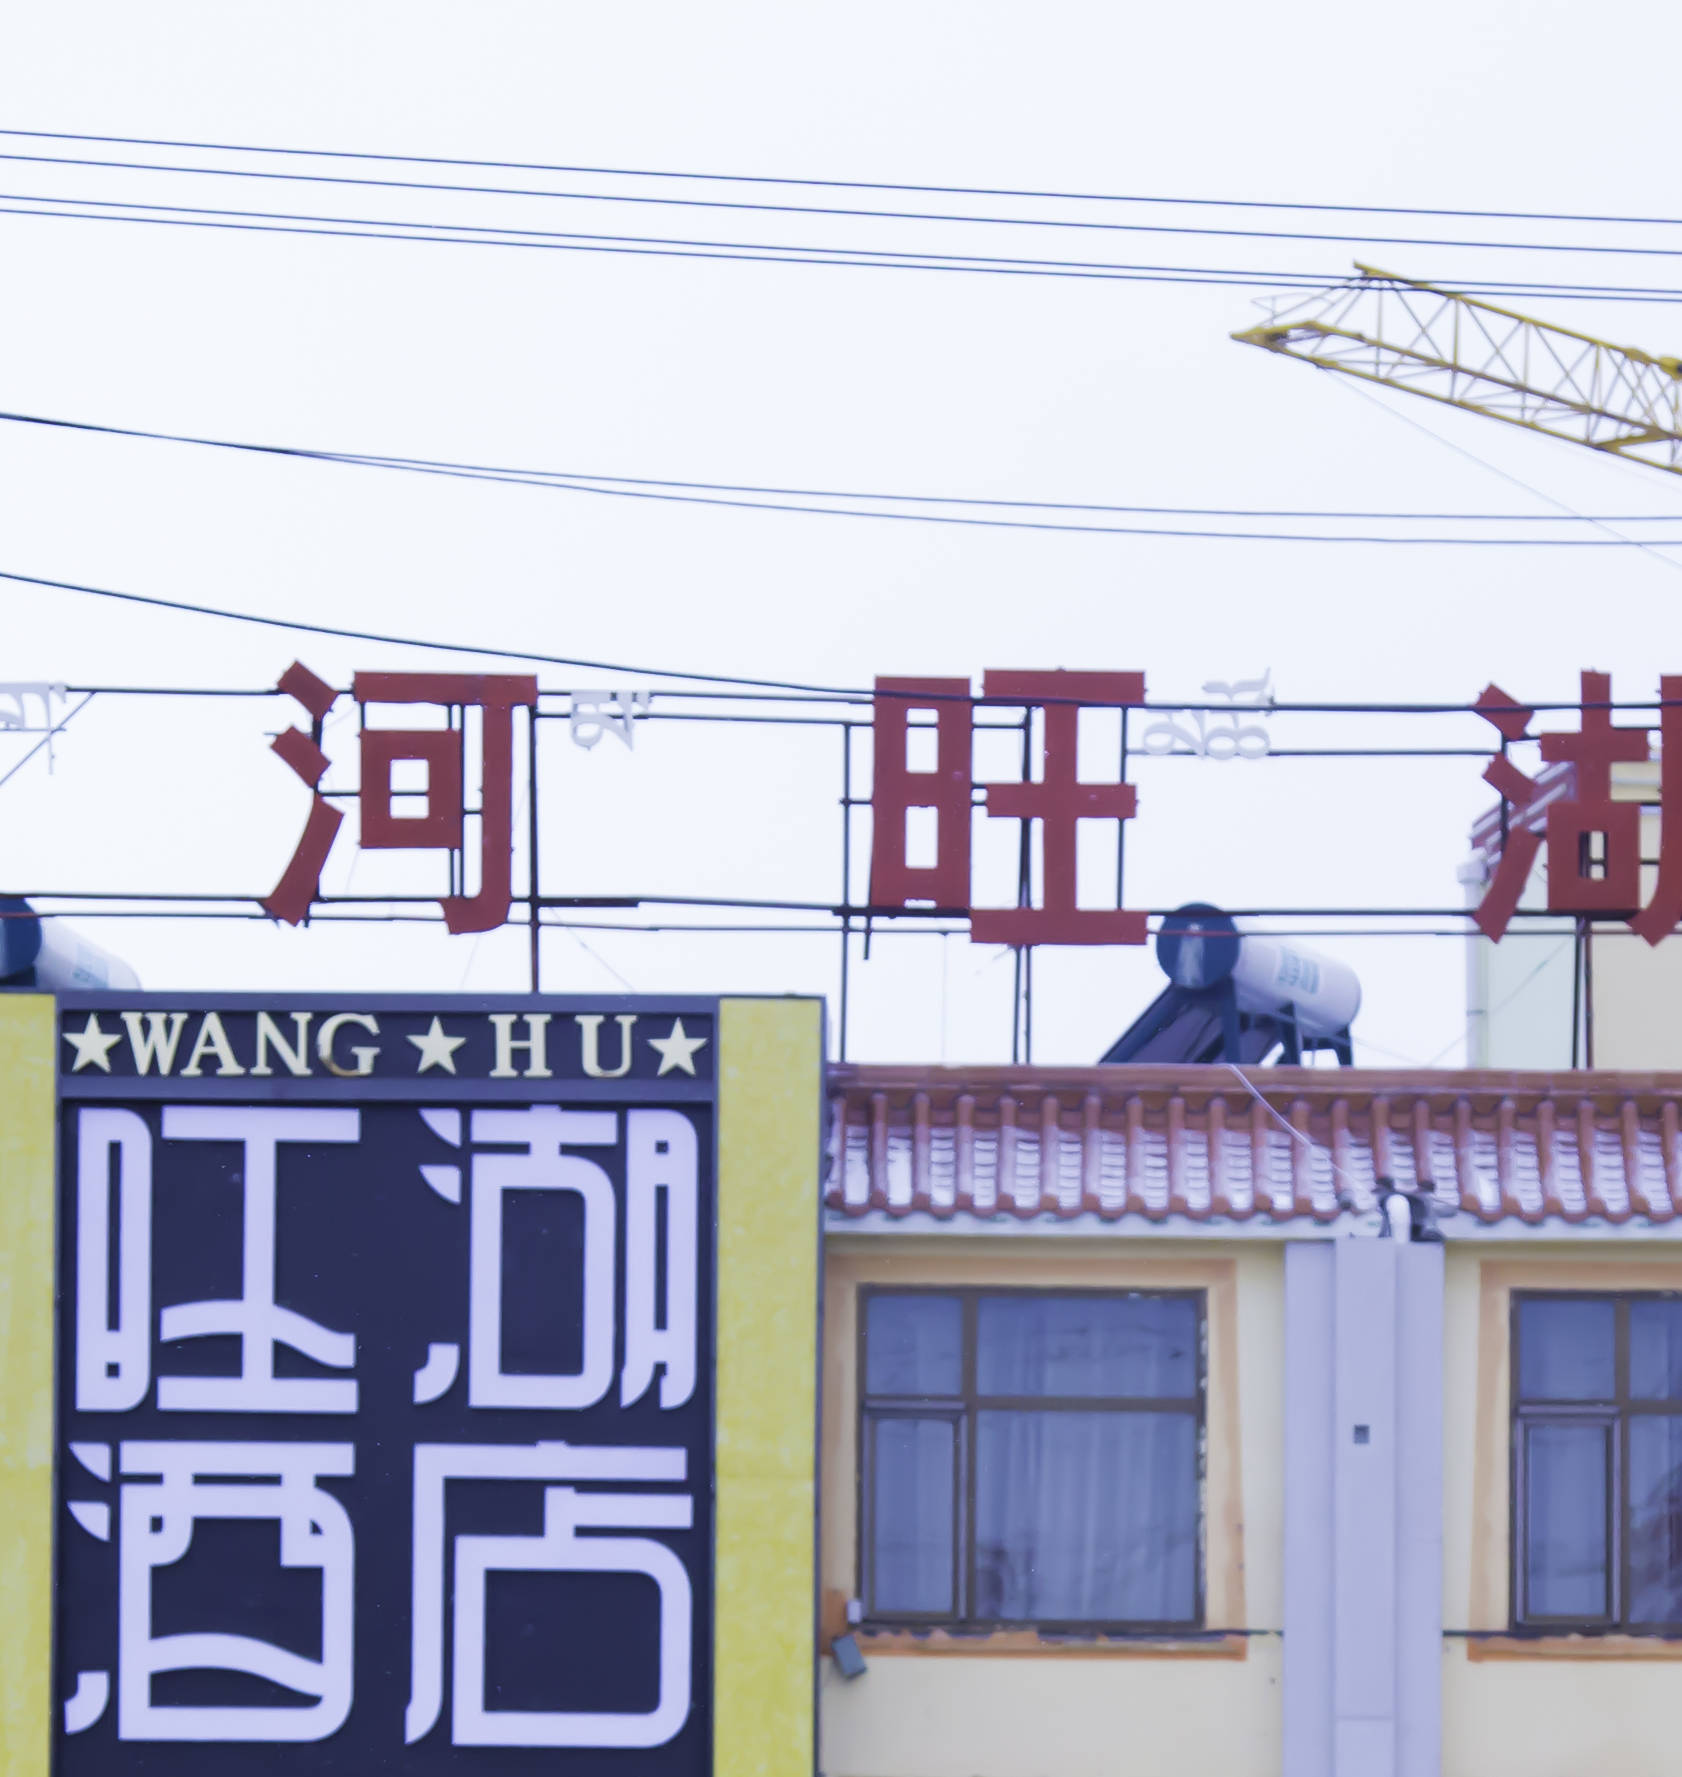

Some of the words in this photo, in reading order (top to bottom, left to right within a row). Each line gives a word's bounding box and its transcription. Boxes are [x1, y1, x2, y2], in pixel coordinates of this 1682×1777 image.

[121, 1012, 382, 1077] WANG
[489, 1014, 638, 1078] HU
[75, 1104, 698, 1413] 旺湖
[65, 1440, 693, 1749] 酒店
